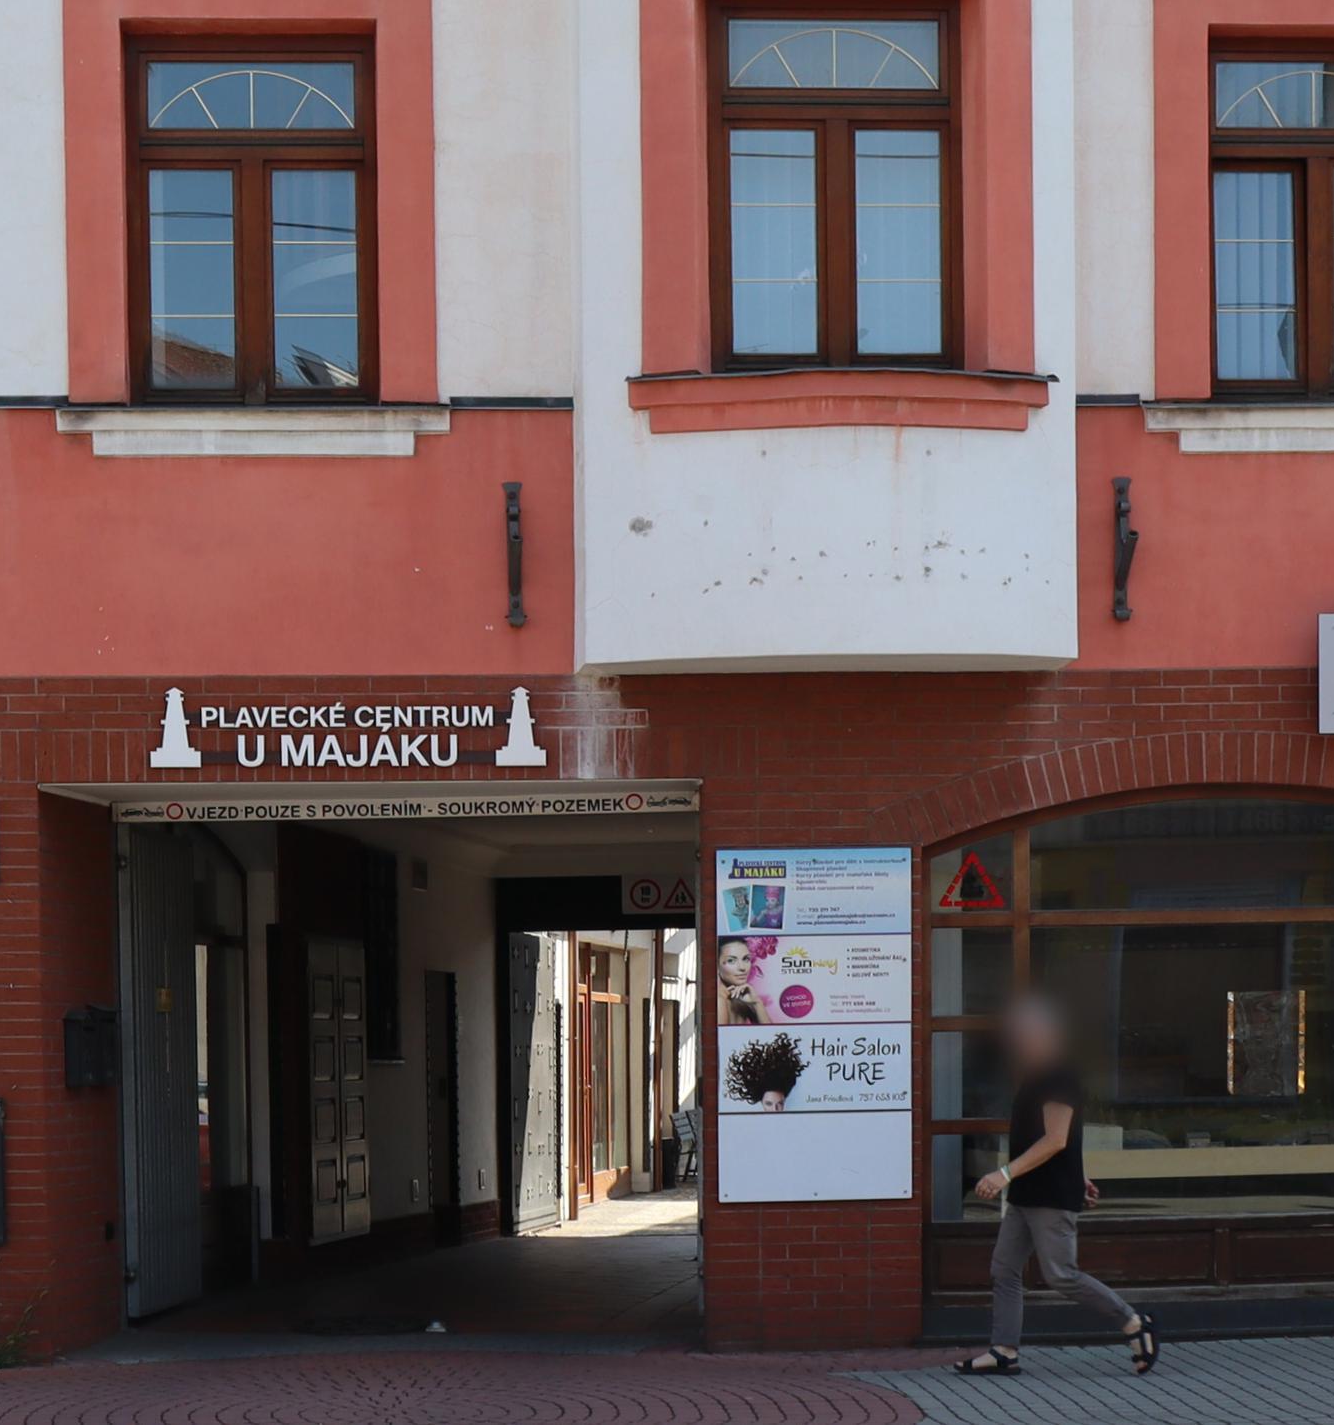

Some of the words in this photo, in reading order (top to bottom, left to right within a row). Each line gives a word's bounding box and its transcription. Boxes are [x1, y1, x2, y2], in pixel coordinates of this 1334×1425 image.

[200, 702, 345, 728] PLAVECKÉ
[354, 705, 494, 728] CENTRUM
[237, 734, 266, 767] U
[281, 724, 458, 767] MAJÁKU
[186, 806, 239, 820] VJEZD
[244, 805, 301, 819] POUZE
[306, 804, 316, 818] S
[322, 800, 422, 817] POVOLENÍM
[438, 797, 535, 815] SOUKROMÝ
[541, 798, 624, 814] POZEMEK
[734, 867, 741, 877] U
[744, 866, 785, 877] MAJÁKU
[810, 1037, 848, 1056] Hair
[851, 1037, 901, 1056] Salon
[826, 1062, 886, 1085] PURE
